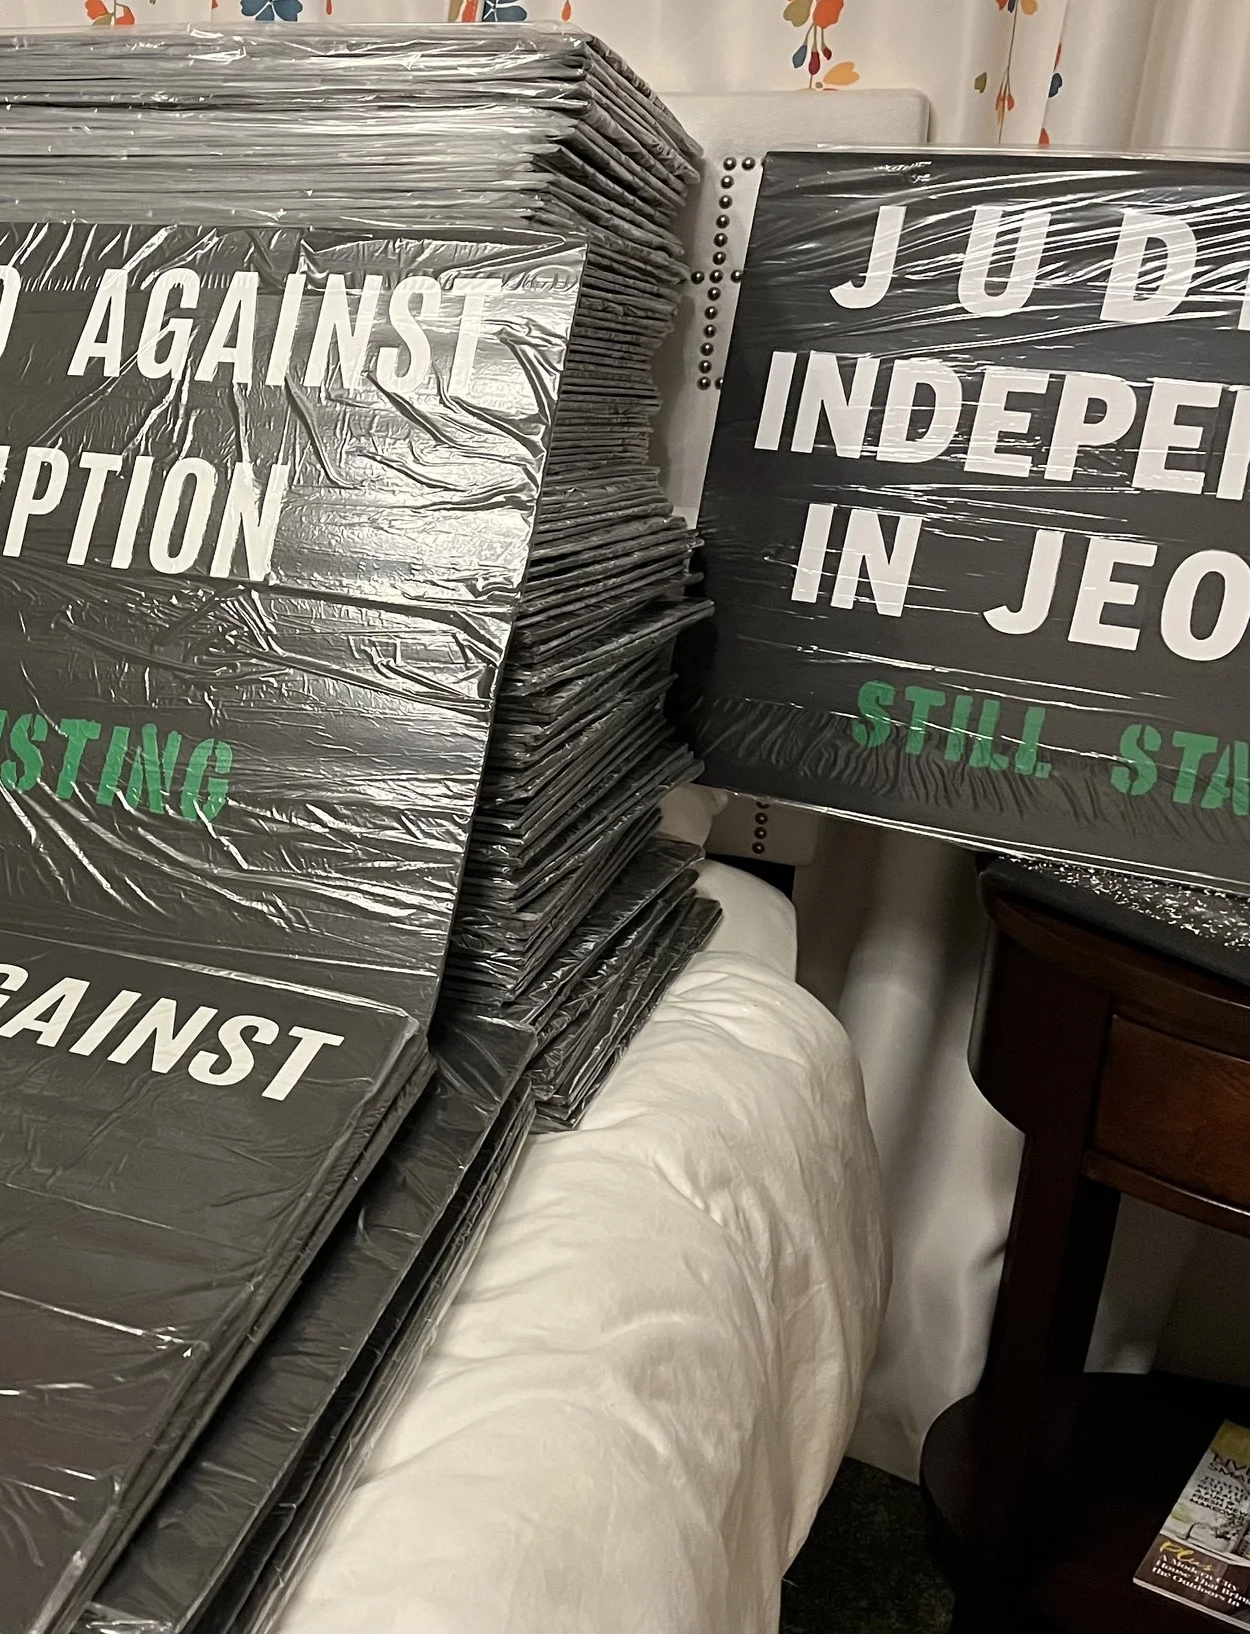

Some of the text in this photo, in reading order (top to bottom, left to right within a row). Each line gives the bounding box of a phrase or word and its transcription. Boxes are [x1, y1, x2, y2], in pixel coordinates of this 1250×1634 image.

[829, 204, 1250, 331] JUD
[67, 268, 502, 397] AGAINST
[791, 503, 1250, 662] IN JEO
[852, 680, 1055, 781] STILL
[1159, 1540, 1213, 1571] Plus
[1172, 1558, 1213, 1581] Modern
[1172, 1575, 1225, 1601] Outdoors
